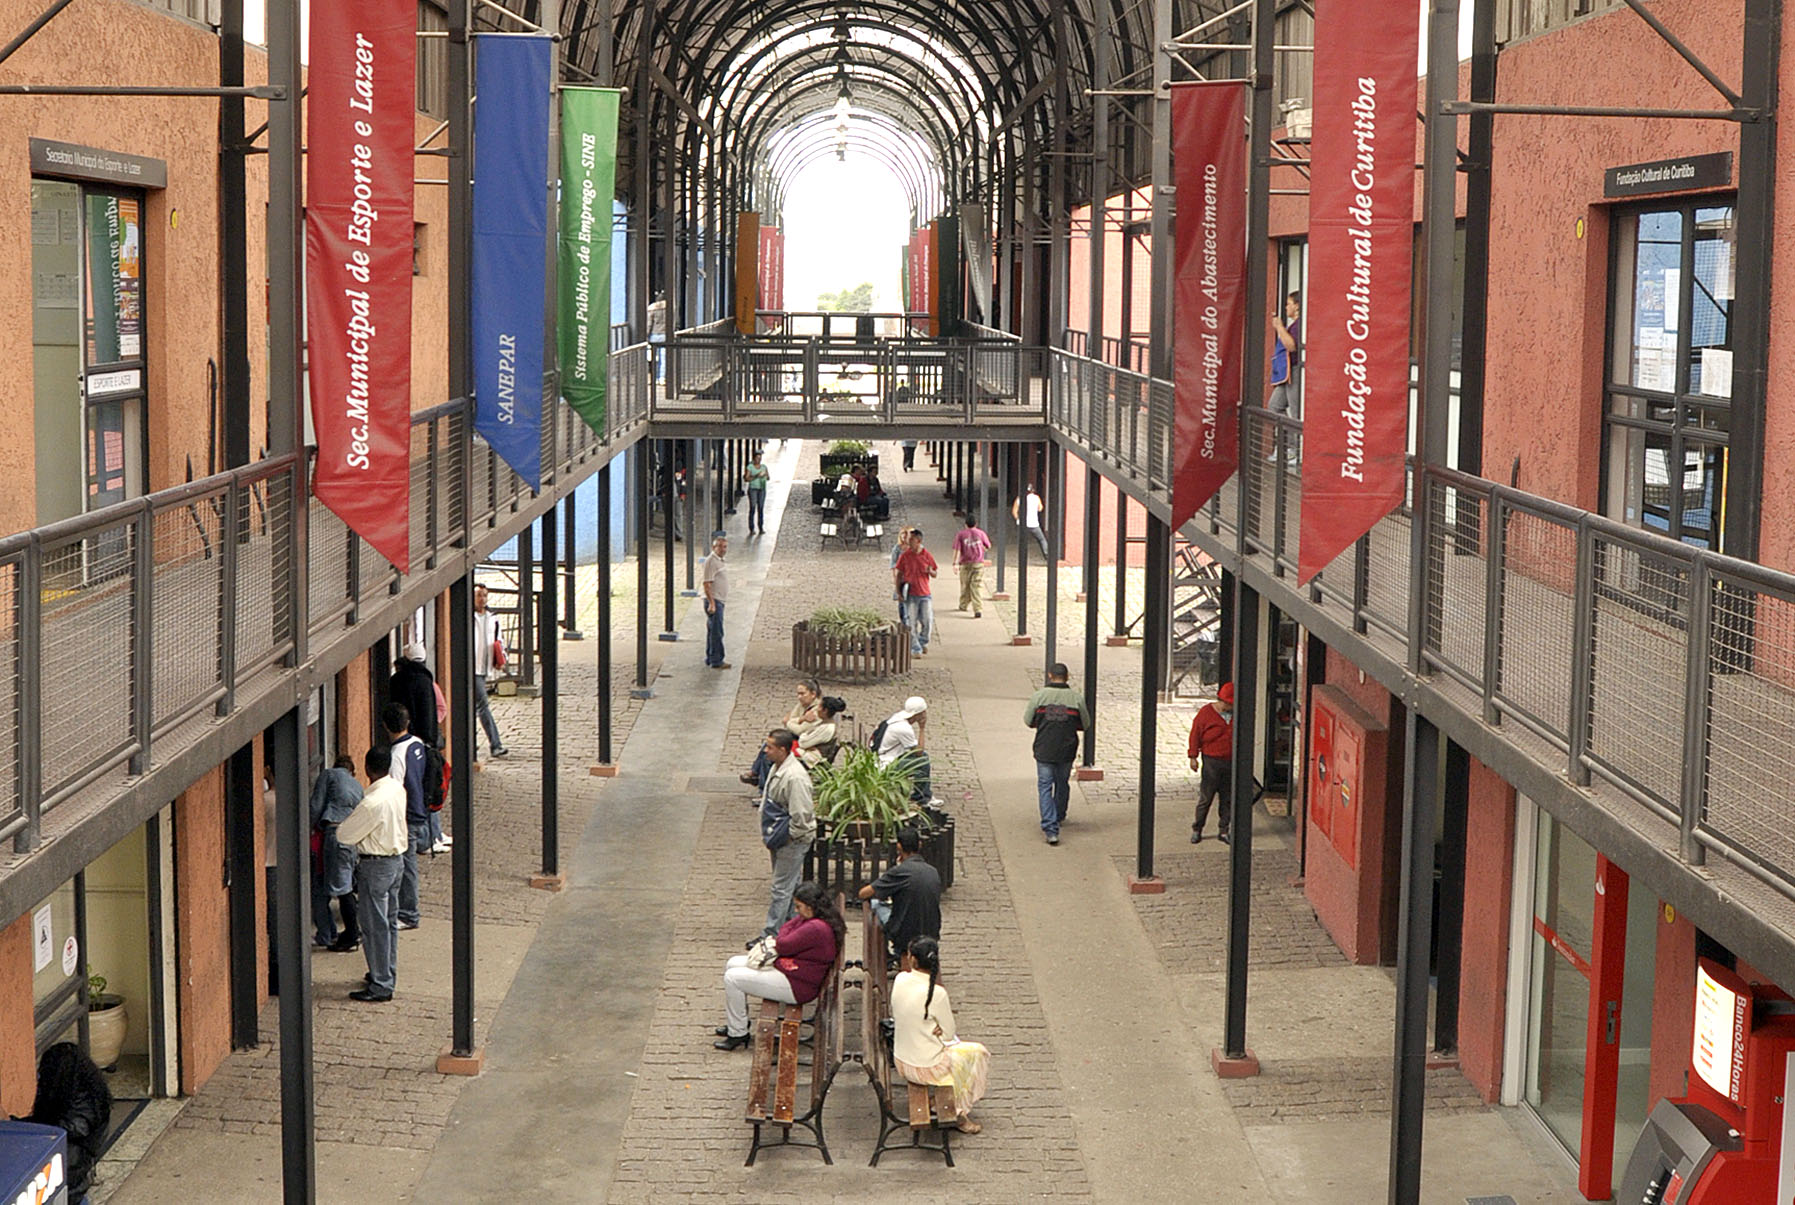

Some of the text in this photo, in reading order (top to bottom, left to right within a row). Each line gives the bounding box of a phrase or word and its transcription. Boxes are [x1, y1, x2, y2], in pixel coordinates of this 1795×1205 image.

[350, 32, 374, 114] Lazer
[354, 120, 373, 137] e
[348, 143, 378, 246] Esporte
[1616, 163, 1695, 187] Fundação Cultural de Curitiba
[578, 179, 597, 243] Emprego
[1200, 164, 1217, 302] Abastecimento
[345, 249, 371, 283] de
[577, 245, 591, 265] de
[1341, 76, 1376, 483] Fundação Cultural de Curitiba
[576, 265, 590, 323] Público
[1201, 306, 1217, 329] do
[497, 334, 516, 425] SANEPAR
[575, 324, 588, 381] Sistema
[1731, 995, 1747, 1101] Banco24Horas
